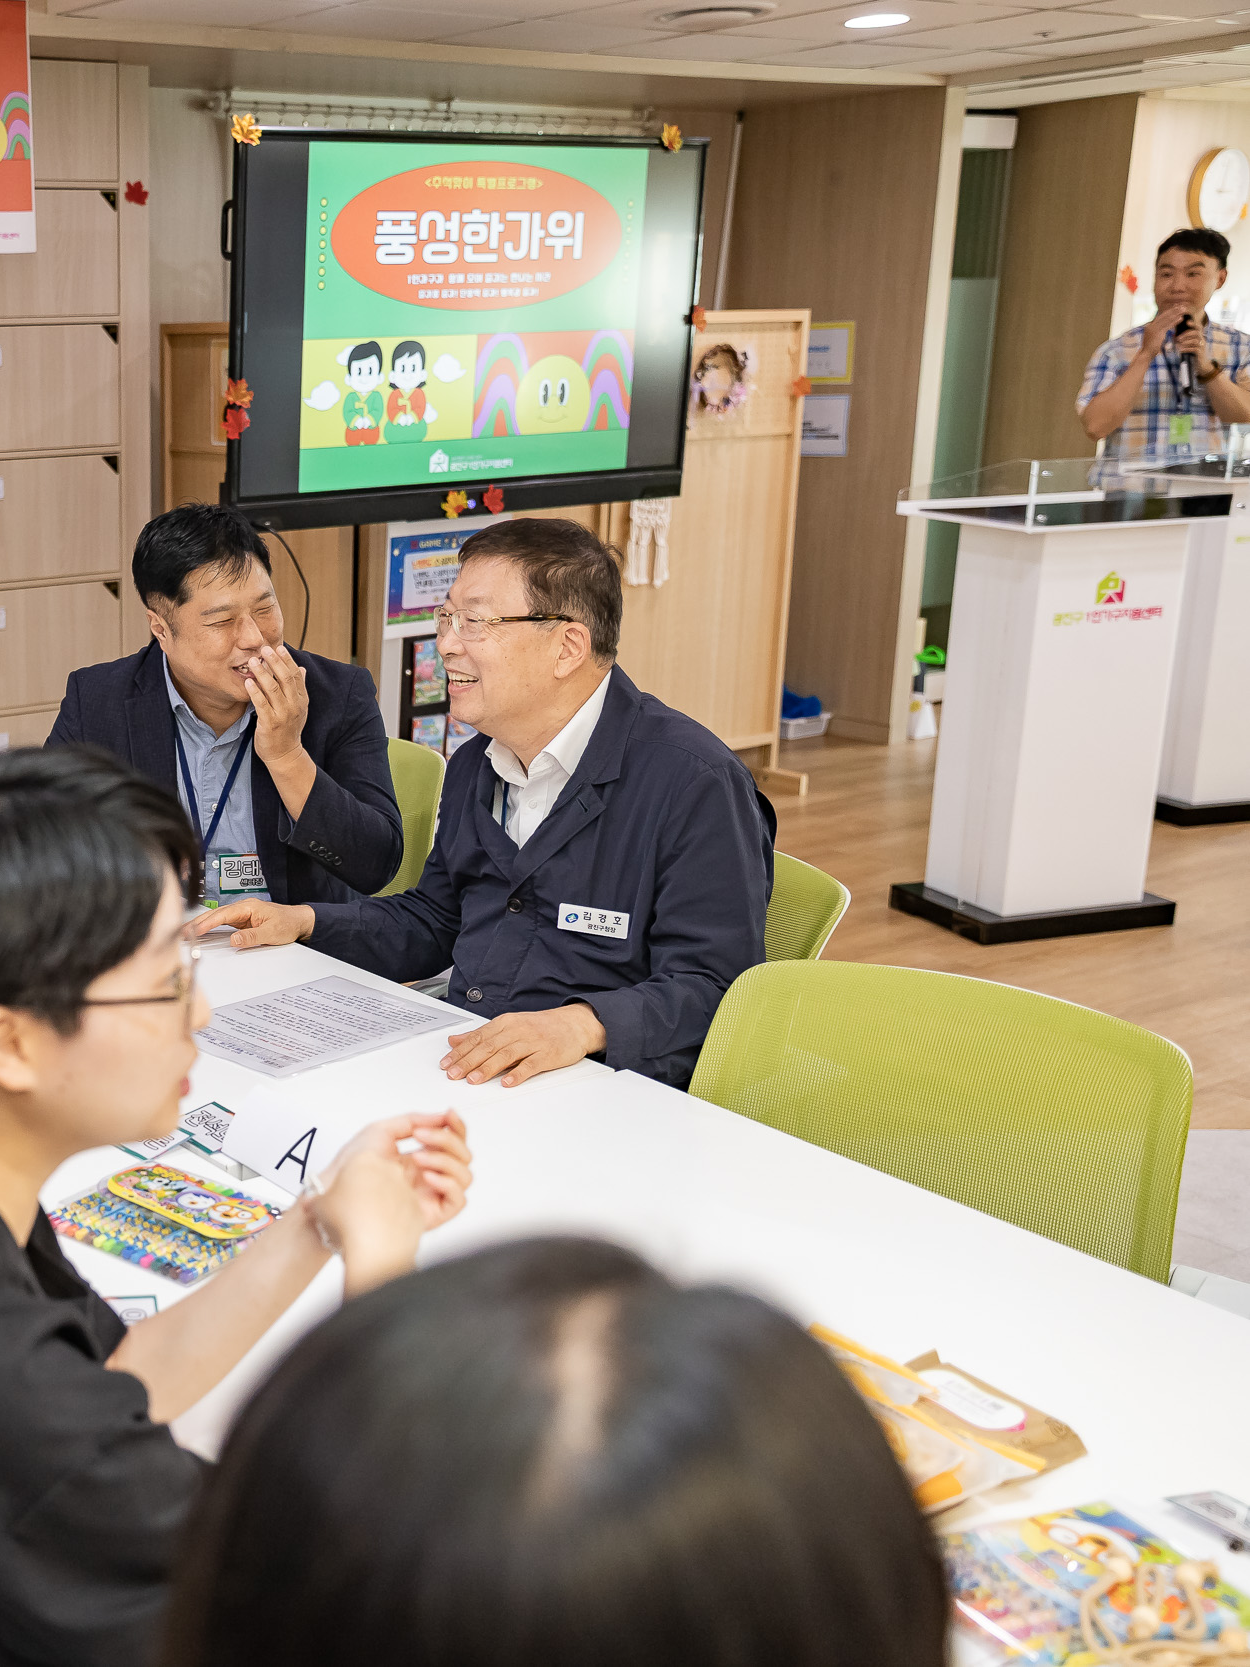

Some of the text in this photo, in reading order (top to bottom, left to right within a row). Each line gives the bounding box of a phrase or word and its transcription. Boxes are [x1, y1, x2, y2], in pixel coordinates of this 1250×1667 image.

[374, 208, 586, 266] 풍성한가위
[224, 859, 262, 879] 김태
[273, 1127, 318, 1185] A
